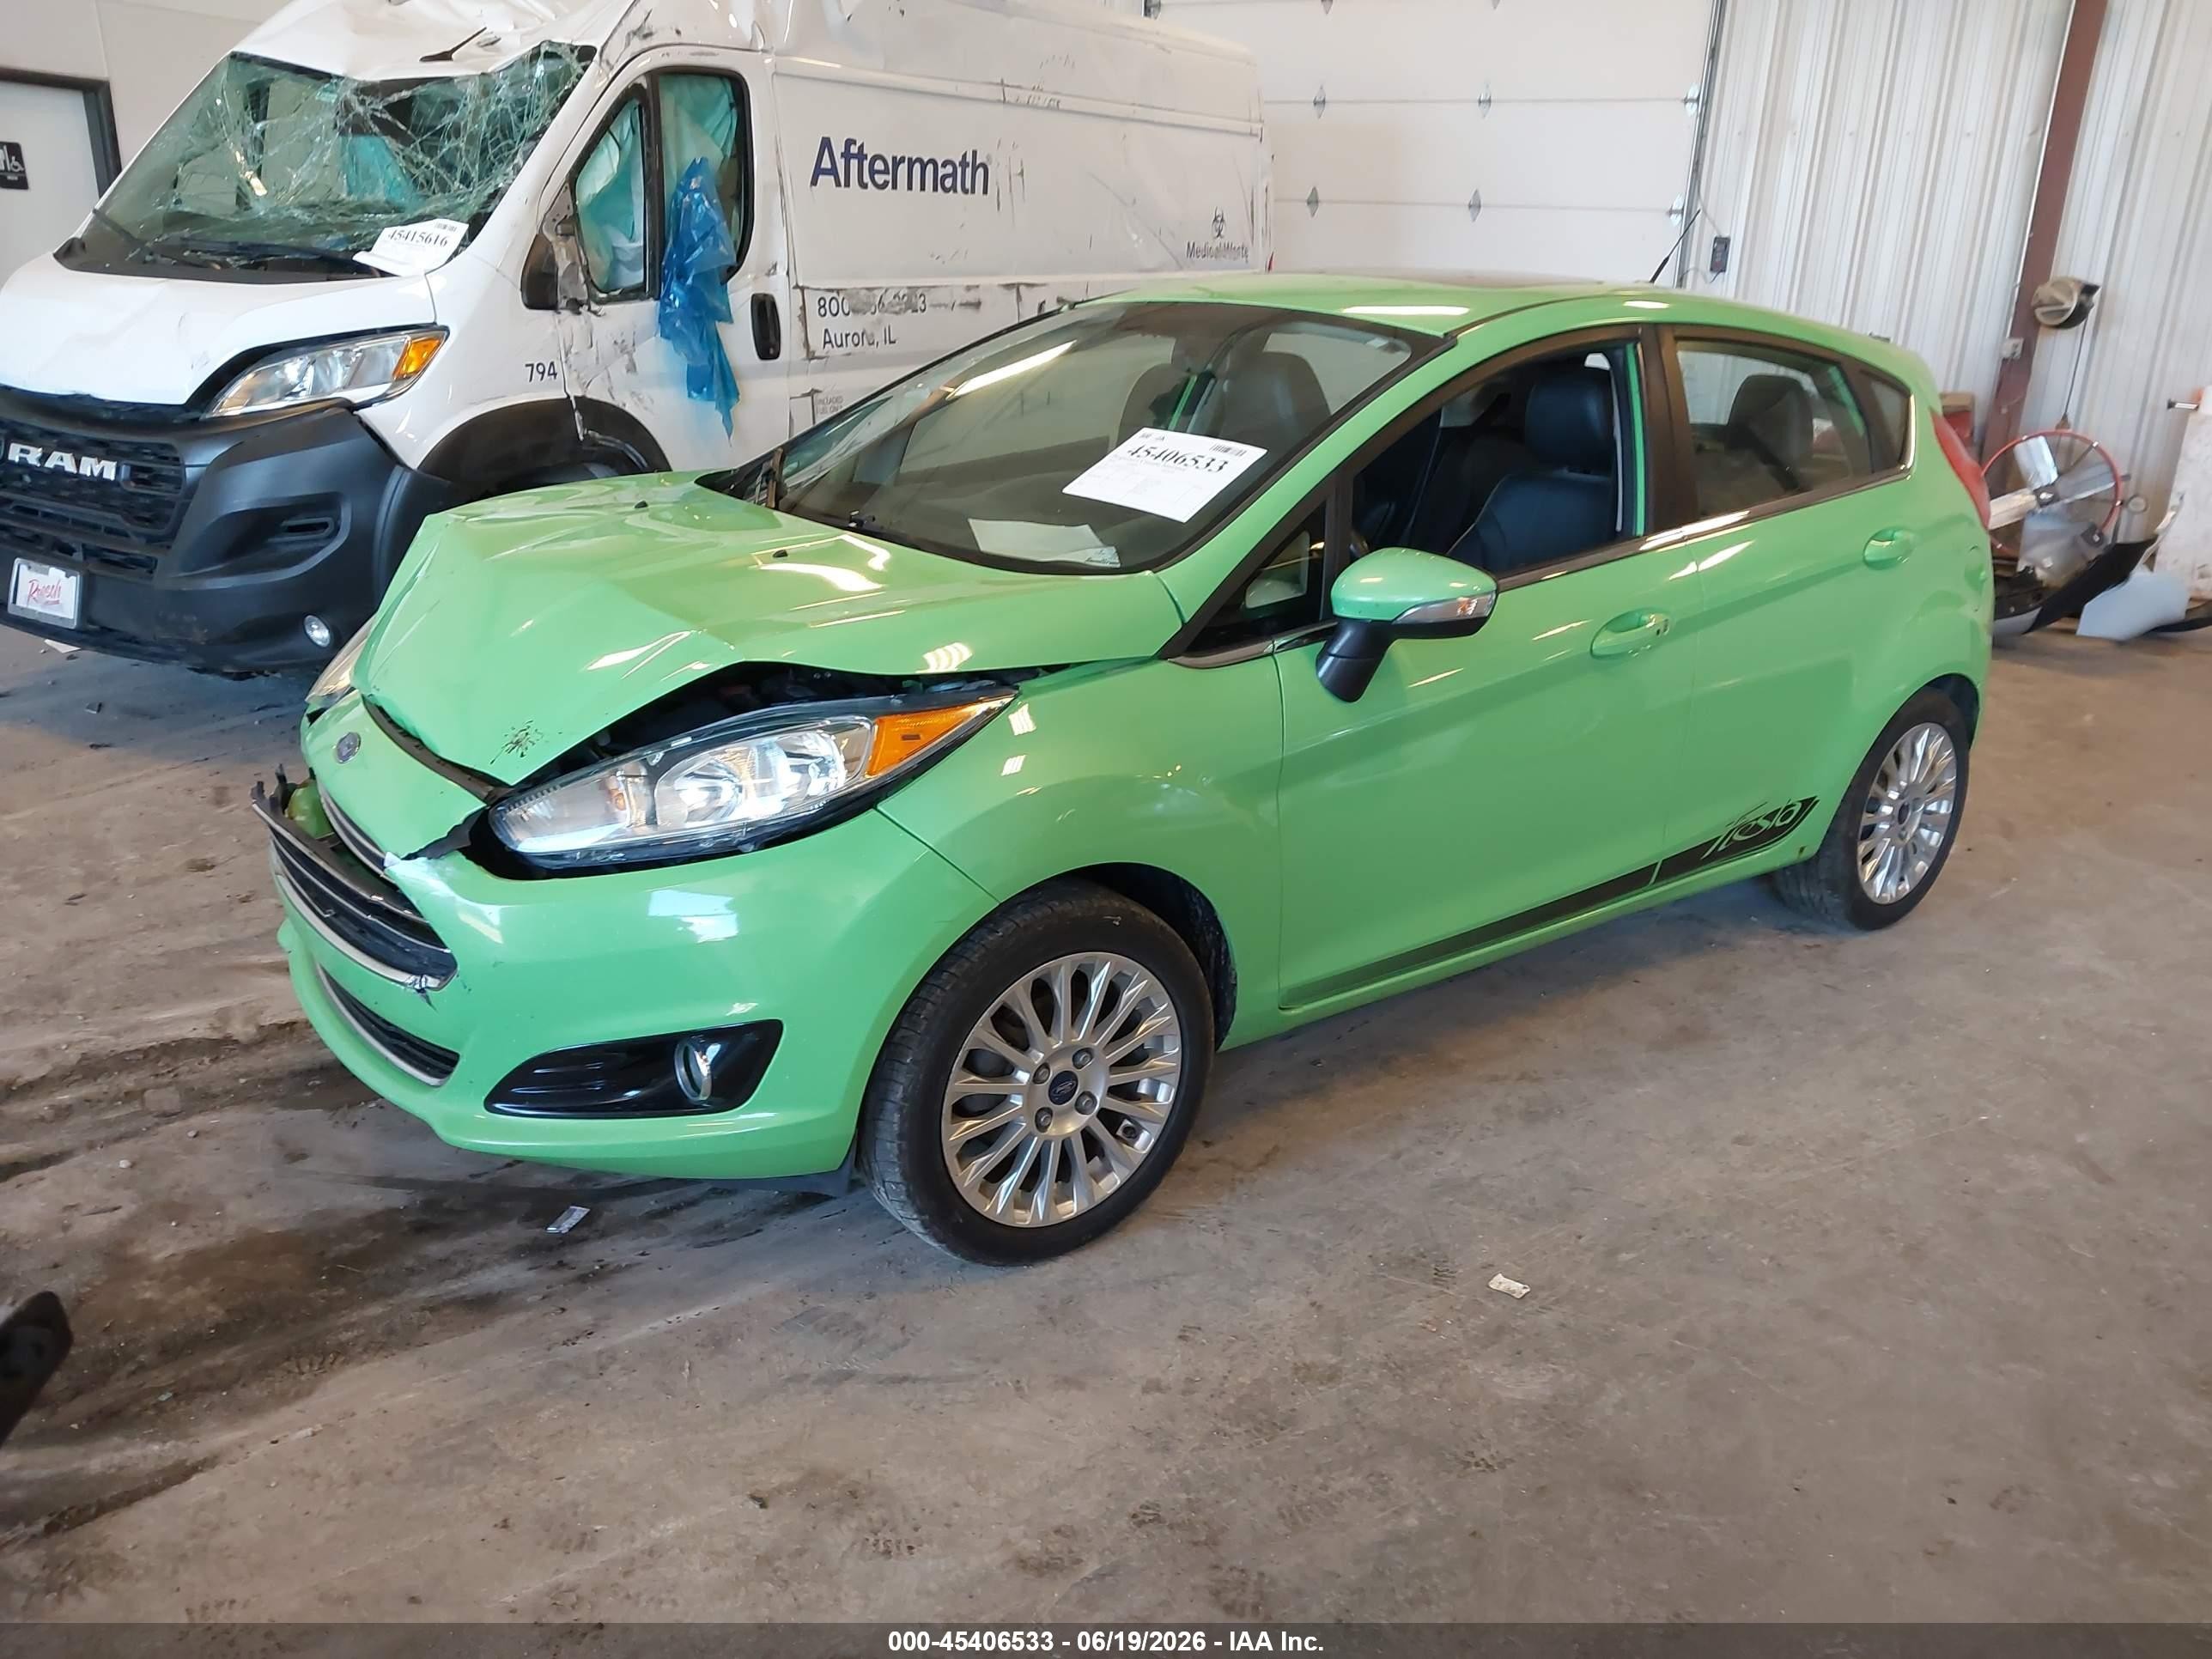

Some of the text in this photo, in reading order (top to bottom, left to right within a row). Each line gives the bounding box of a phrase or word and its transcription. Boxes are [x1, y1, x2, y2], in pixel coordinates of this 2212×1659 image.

[810, 137, 989, 195] Aftermath
[388, 229, 448, 247] 45415616
[884, 325, 896, 346] IL
[525, 361, 558, 383] 794
[8, 442, 118, 482] RAM
[1127, 444, 1229, 473] 45406533
